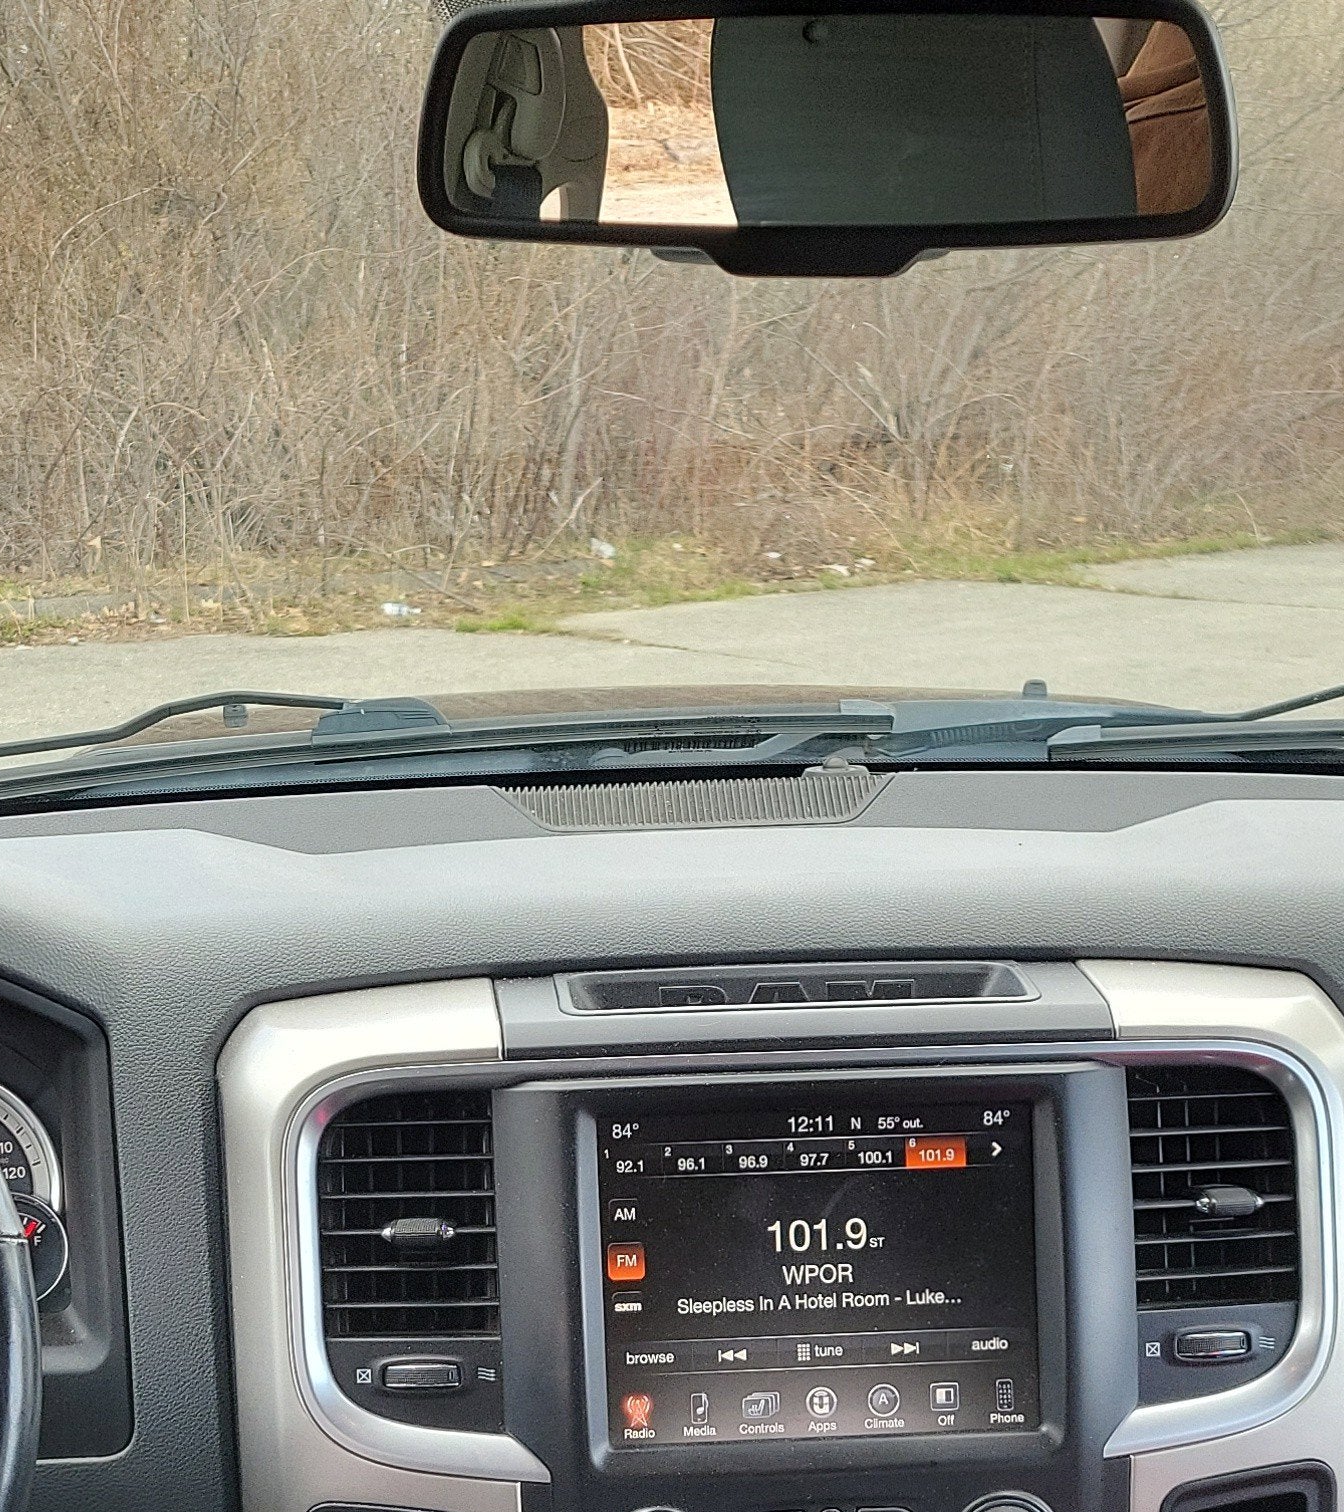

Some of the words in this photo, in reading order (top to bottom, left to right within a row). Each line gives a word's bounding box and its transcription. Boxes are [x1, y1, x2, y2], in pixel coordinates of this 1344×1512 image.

[787, 1116, 834, 1132] 12:11
[850, 1117, 861, 1130] N
[877, 1116, 900, 1130] 55°
[982, 1110, 1010, 1126] 84°
[612, 1122, 640, 1139] 84°
[726, 1144, 733, 1154] 3
[786, 1142, 794, 1152] 4
[848, 1140, 855, 1150] 5
[908, 1138, 916, 1148] 6
[604, 1150, 610, 1160] 1
[664, 1146, 672, 1157] 2
[857, 1150, 893, 1164] 100.1
[918, 1148, 954, 1162] 101.9
[616, 1159, 644, 1174] 92.1
[678, 1156, 706, 1172] 96.1
[738, 1154, 768, 1170] 96.9
[800, 1152, 829, 1167] 97.7
[4, 1166, 26, 1180] 120
[614, 1208, 636, 1222] AM
[34, 1236, 42, 1246] F
[766, 1217, 869, 1252] 101.9
[616, 1254, 638, 1268] FM
[782, 1264, 854, 1286] WPOR
[678, 1297, 754, 1317] Sleepless
[758, 1296, 774, 1311] In
[778, 1296, 792, 1310] A
[795, 1292, 838, 1310] Hotel
[842, 1292, 890, 1308] Room
[972, 1336, 1008, 1351] audio
[626, 1350, 674, 1366] browse
[814, 1344, 843, 1358] tune
[864, 1417, 904, 1430] Climate
[938, 1414, 955, 1426] Off
[990, 1412, 1024, 1425] Phone
[624, 1426, 656, 1440] Radio
[682, 1424, 716, 1437] Media
[738, 1422, 784, 1434] Controls
[808, 1420, 837, 1434] Apps
